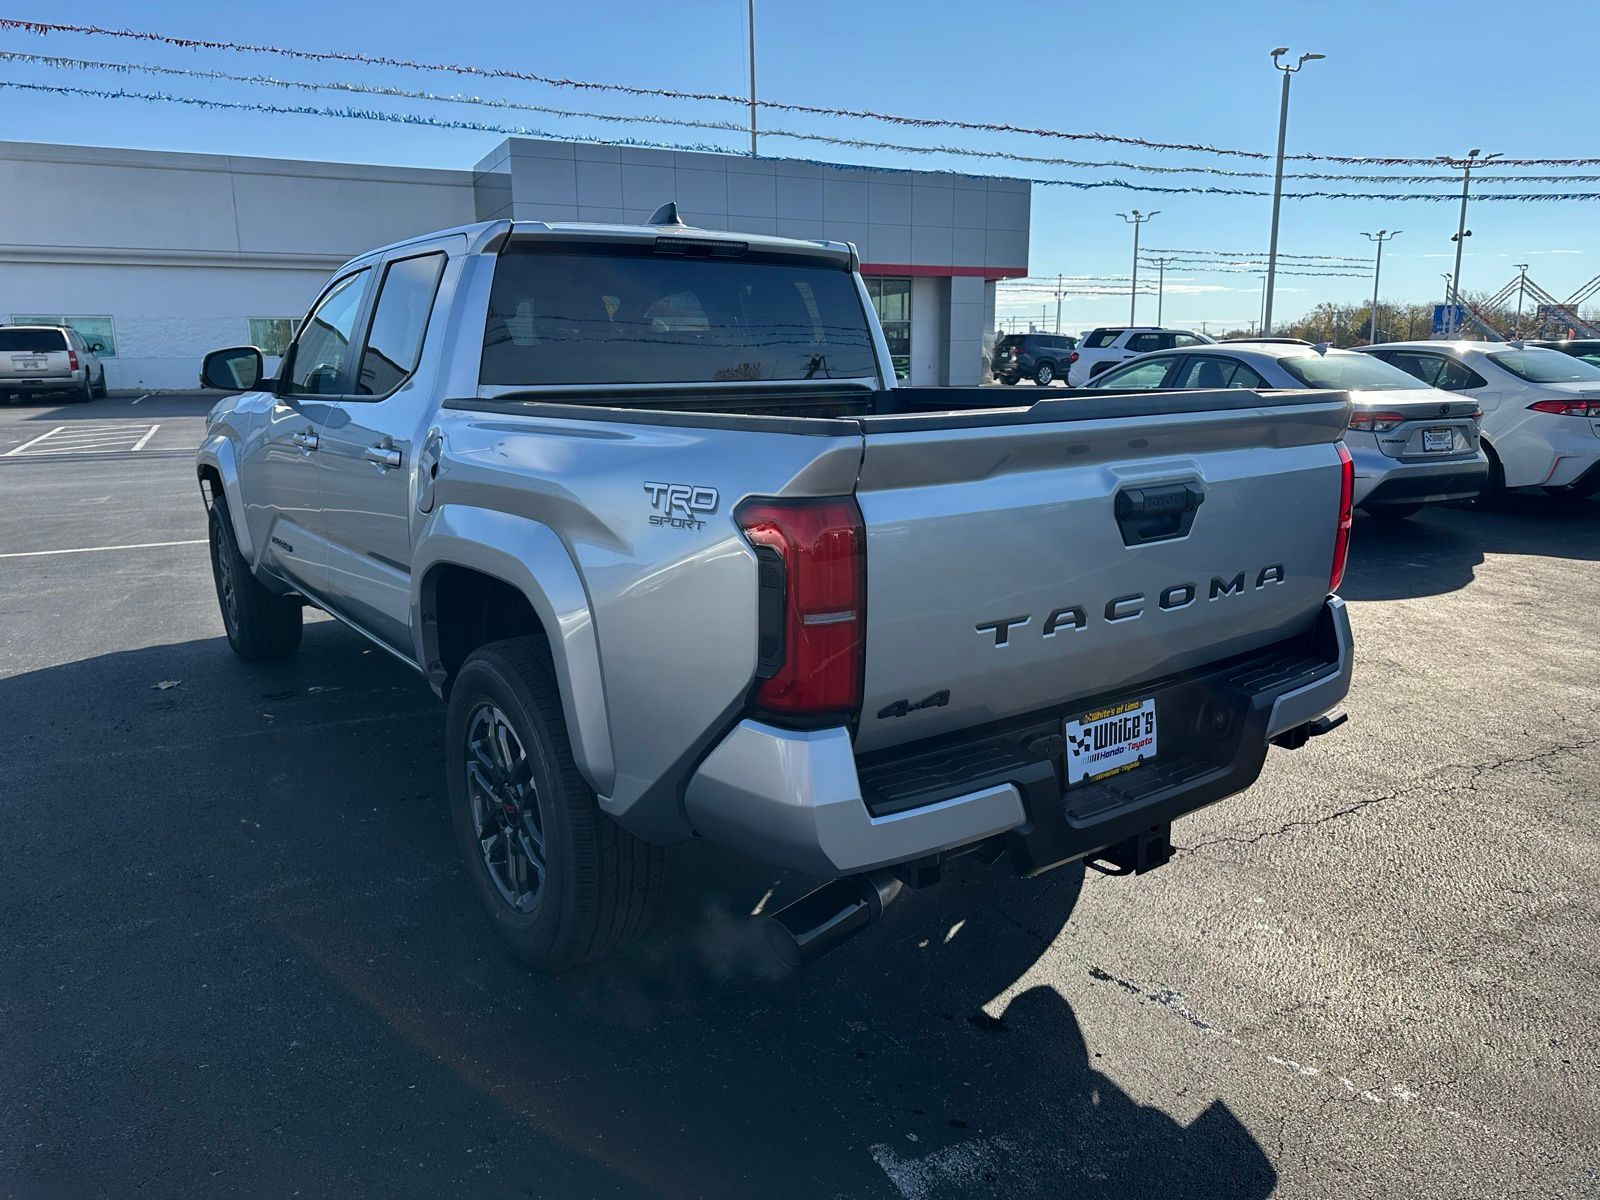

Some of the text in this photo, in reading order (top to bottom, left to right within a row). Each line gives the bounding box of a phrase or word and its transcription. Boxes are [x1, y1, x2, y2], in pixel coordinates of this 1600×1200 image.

[644, 481, 720, 518] TRD
[1146, 493, 1185, 508] TOYOTA
[648, 515, 707, 532] SPORT
[975, 562, 1285, 648] TACOMA
[1116, 704, 1125, 714] of
[1125, 702, 1140, 712] Lima
